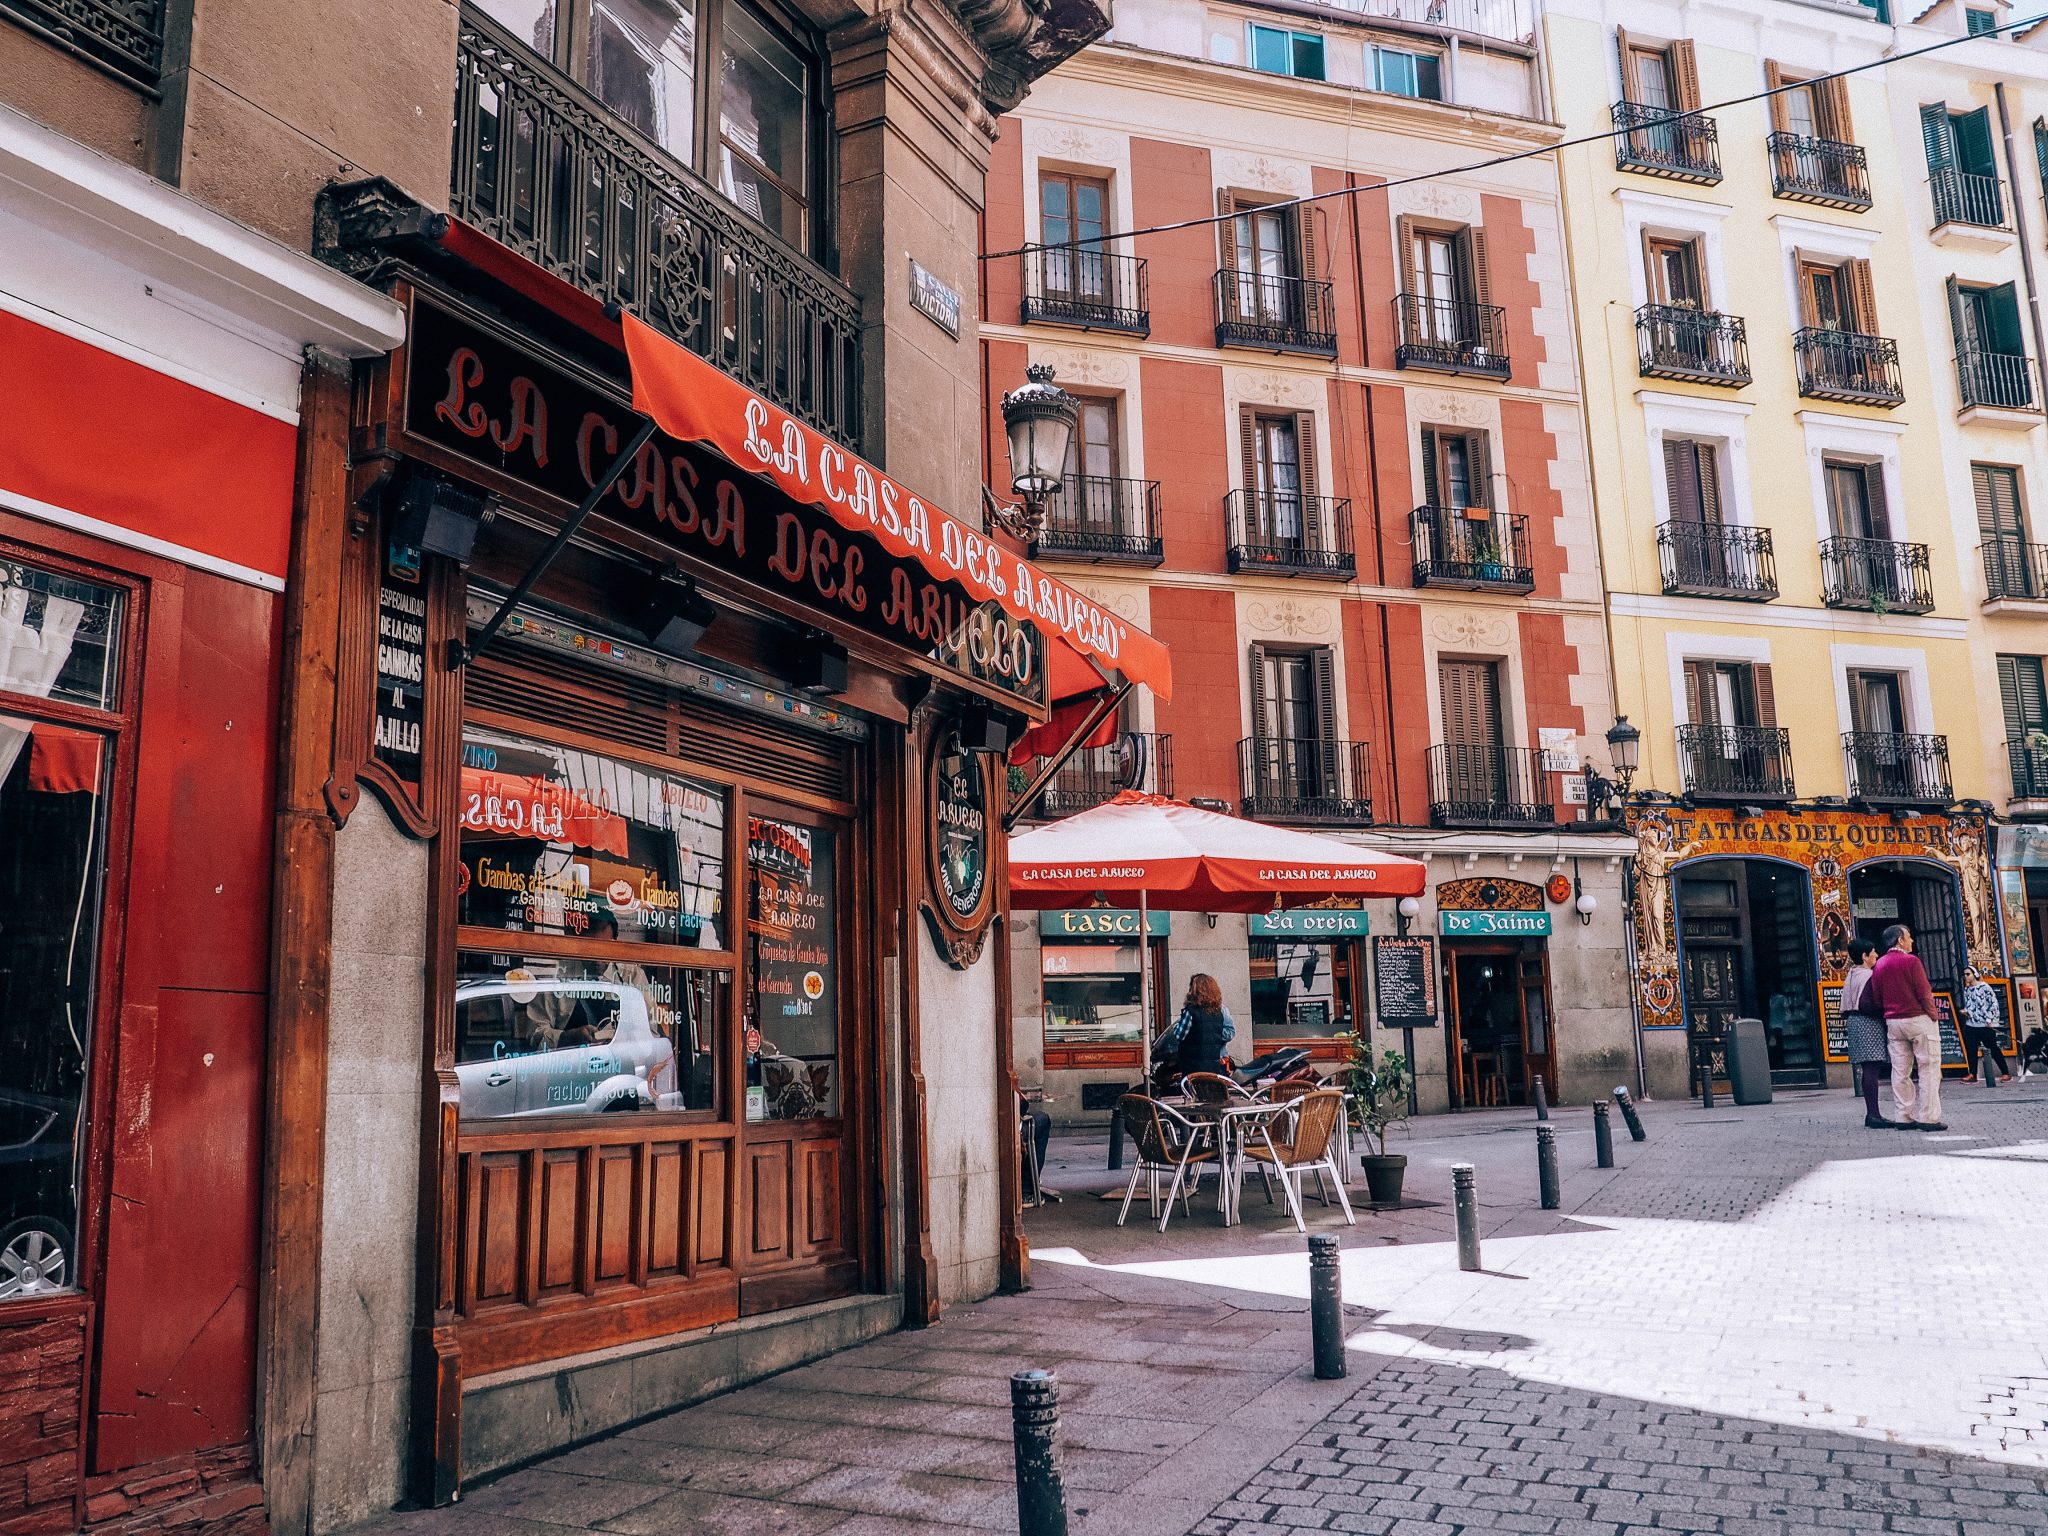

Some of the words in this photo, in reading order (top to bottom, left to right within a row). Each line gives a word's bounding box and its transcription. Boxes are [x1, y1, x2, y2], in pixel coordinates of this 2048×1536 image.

[928, 275, 960, 307] CALLE
[919, 288, 958, 333] VICTORIA
[435, 347, 549, 469] LA
[576, 411, 746, 559] CASA
[768, 512, 867, 612] DEL
[881, 566, 1032, 686] ABUELO
[743, 398, 810, 486] LA
[819, 443, 932, 556] CASA
[939, 519, 1007, 597] DEL
[1013, 562, 1119, 660] ABUELO
[380, 587, 425, 617] ESPECIALIDAD
[380, 615, 391, 637] DE
[392, 617, 402, 640] LA
[402, 622, 423, 646] CASA
[378, 644, 422, 683] GAMBAS
[392, 687, 406, 710] AL
[374, 715, 420, 755] AJILLO
[1550, 761, 1572, 770] CRUZ
[954, 776, 968, 799] EL
[937, 800, 983, 831] ABUELO
[1674, 818, 1793, 843] FATIGAS
[1796, 823, 1844, 843] DEL
[1847, 823, 1948, 849] QUERER
[477, 857, 526, 892] Gambas
[1022, 869, 1038, 880] LA
[1040, 868, 1073, 880] CASA
[1074, 868, 1098, 878] DEL
[1099, 867, 1145, 878] ABUELO
[1259, 869, 1275, 880] LA
[1276, 869, 1308, 880] CASA
[1309, 869, 1332, 880] DEL
[1332, 869, 1377, 880] ABUELO
[1822, 862, 1833, 875] 17
[640, 877, 680, 909] Gambas
[758, 886, 773, 901] LA
[776, 888, 803, 905] CASA
[806, 893, 825, 908] DEL
[941, 863, 953, 897] VINO
[952, 869, 983, 911] GENEROSO
[519, 890, 558, 909] Gamba
[562, 896, 600, 914] Blanca
[525, 905, 565, 927] Gamba
[564, 910, 589, 935] Roja
[636, 908, 667, 930] 10,90
[769, 911, 816, 930] ABUELO
[1060, 911, 1153, 933] tasca
[1263, 911, 1295, 930] La
[1303, 912, 1358, 934] oreja
[1448, 913, 1471, 930] de
[1479, 913, 1546, 933] Jaime
[758, 937, 789, 964] Croquetas
